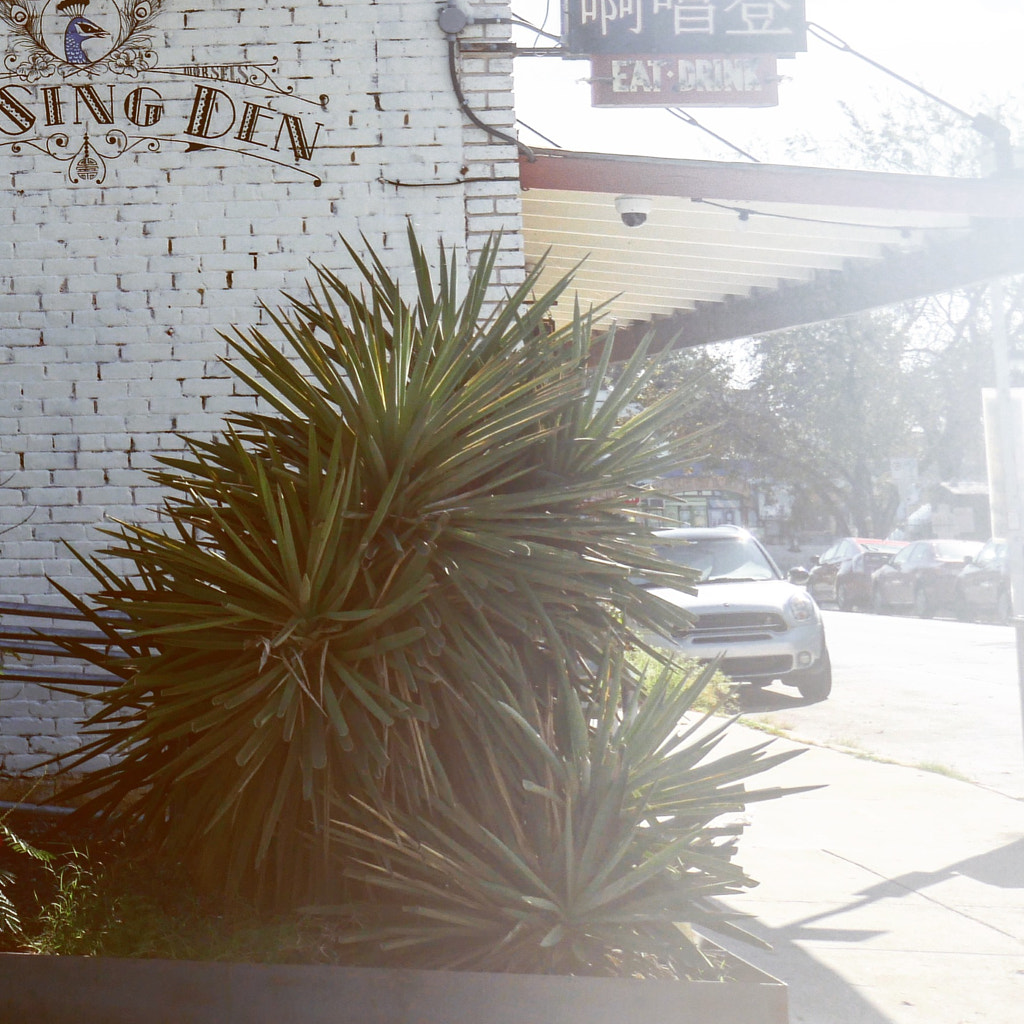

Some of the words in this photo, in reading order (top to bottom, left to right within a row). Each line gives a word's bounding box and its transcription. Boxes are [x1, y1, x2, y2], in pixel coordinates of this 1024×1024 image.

[183, 64, 249, 84] MORSELS
[611, 59, 666, 93] EAT
[678, 58, 763, 93] DRINK
[183, 83, 324, 161] DEN
